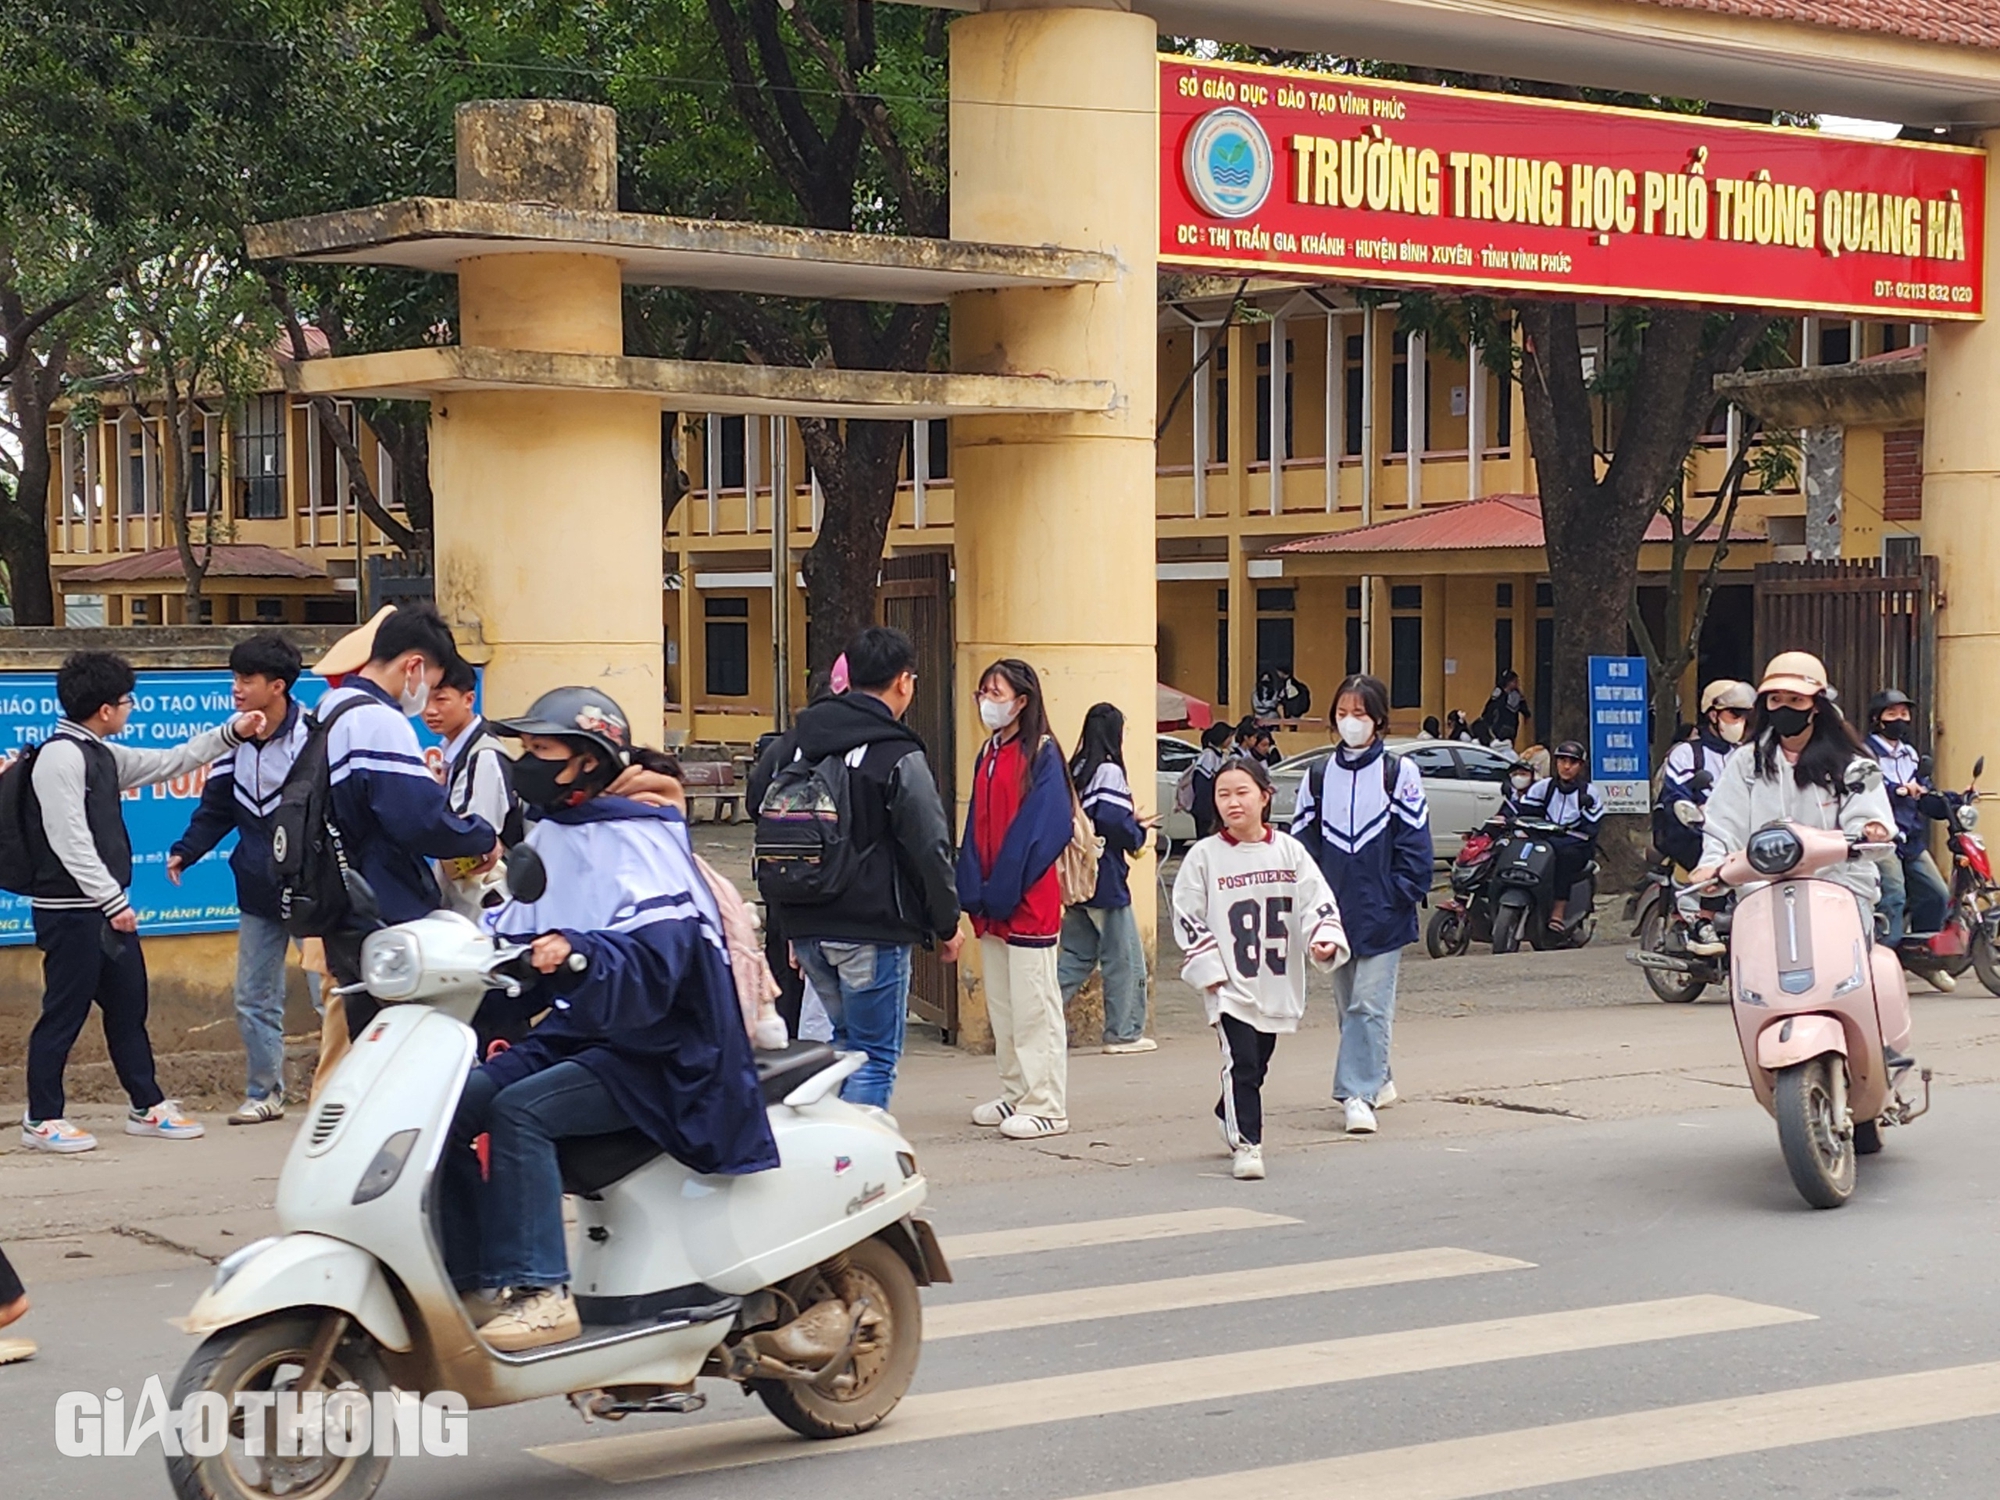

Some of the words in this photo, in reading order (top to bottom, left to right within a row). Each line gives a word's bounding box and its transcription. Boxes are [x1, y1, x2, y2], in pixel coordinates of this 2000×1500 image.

[1202, 76, 1235, 101] GIÁO
[1240, 84, 1268, 107] DỤC
[1309, 92, 1336, 116] TẠO
[1293, 124, 1440, 216] TRƯỜNG
[1450, 152, 1563, 227] TRUNG
[1571, 163, 1636, 246] HỌC
[1644, 145, 1708, 239] PHỔ
[1716, 169, 1815, 248] THÔNG
[1823, 189, 1921, 258] QUANG
[1927, 189, 1966, 261] HÀ
[1208, 227, 1230, 251] THỊ
[1233, 223, 1270, 250] TRẤN
[1273, 231, 1297, 253] GIA
[1301, 231, 1345, 257] KHÁNH
[1355, 236, 1397, 265] HUYỆN
[1432, 242, 1473, 267] XUYÊN
[1896, 281, 1927, 300] 02113
[1928, 283, 1950, 302] 832
[1951, 285, 1973, 303] 020
[158, 694, 197, 715] TẠO
[1228, 896, 1293, 978] 85
